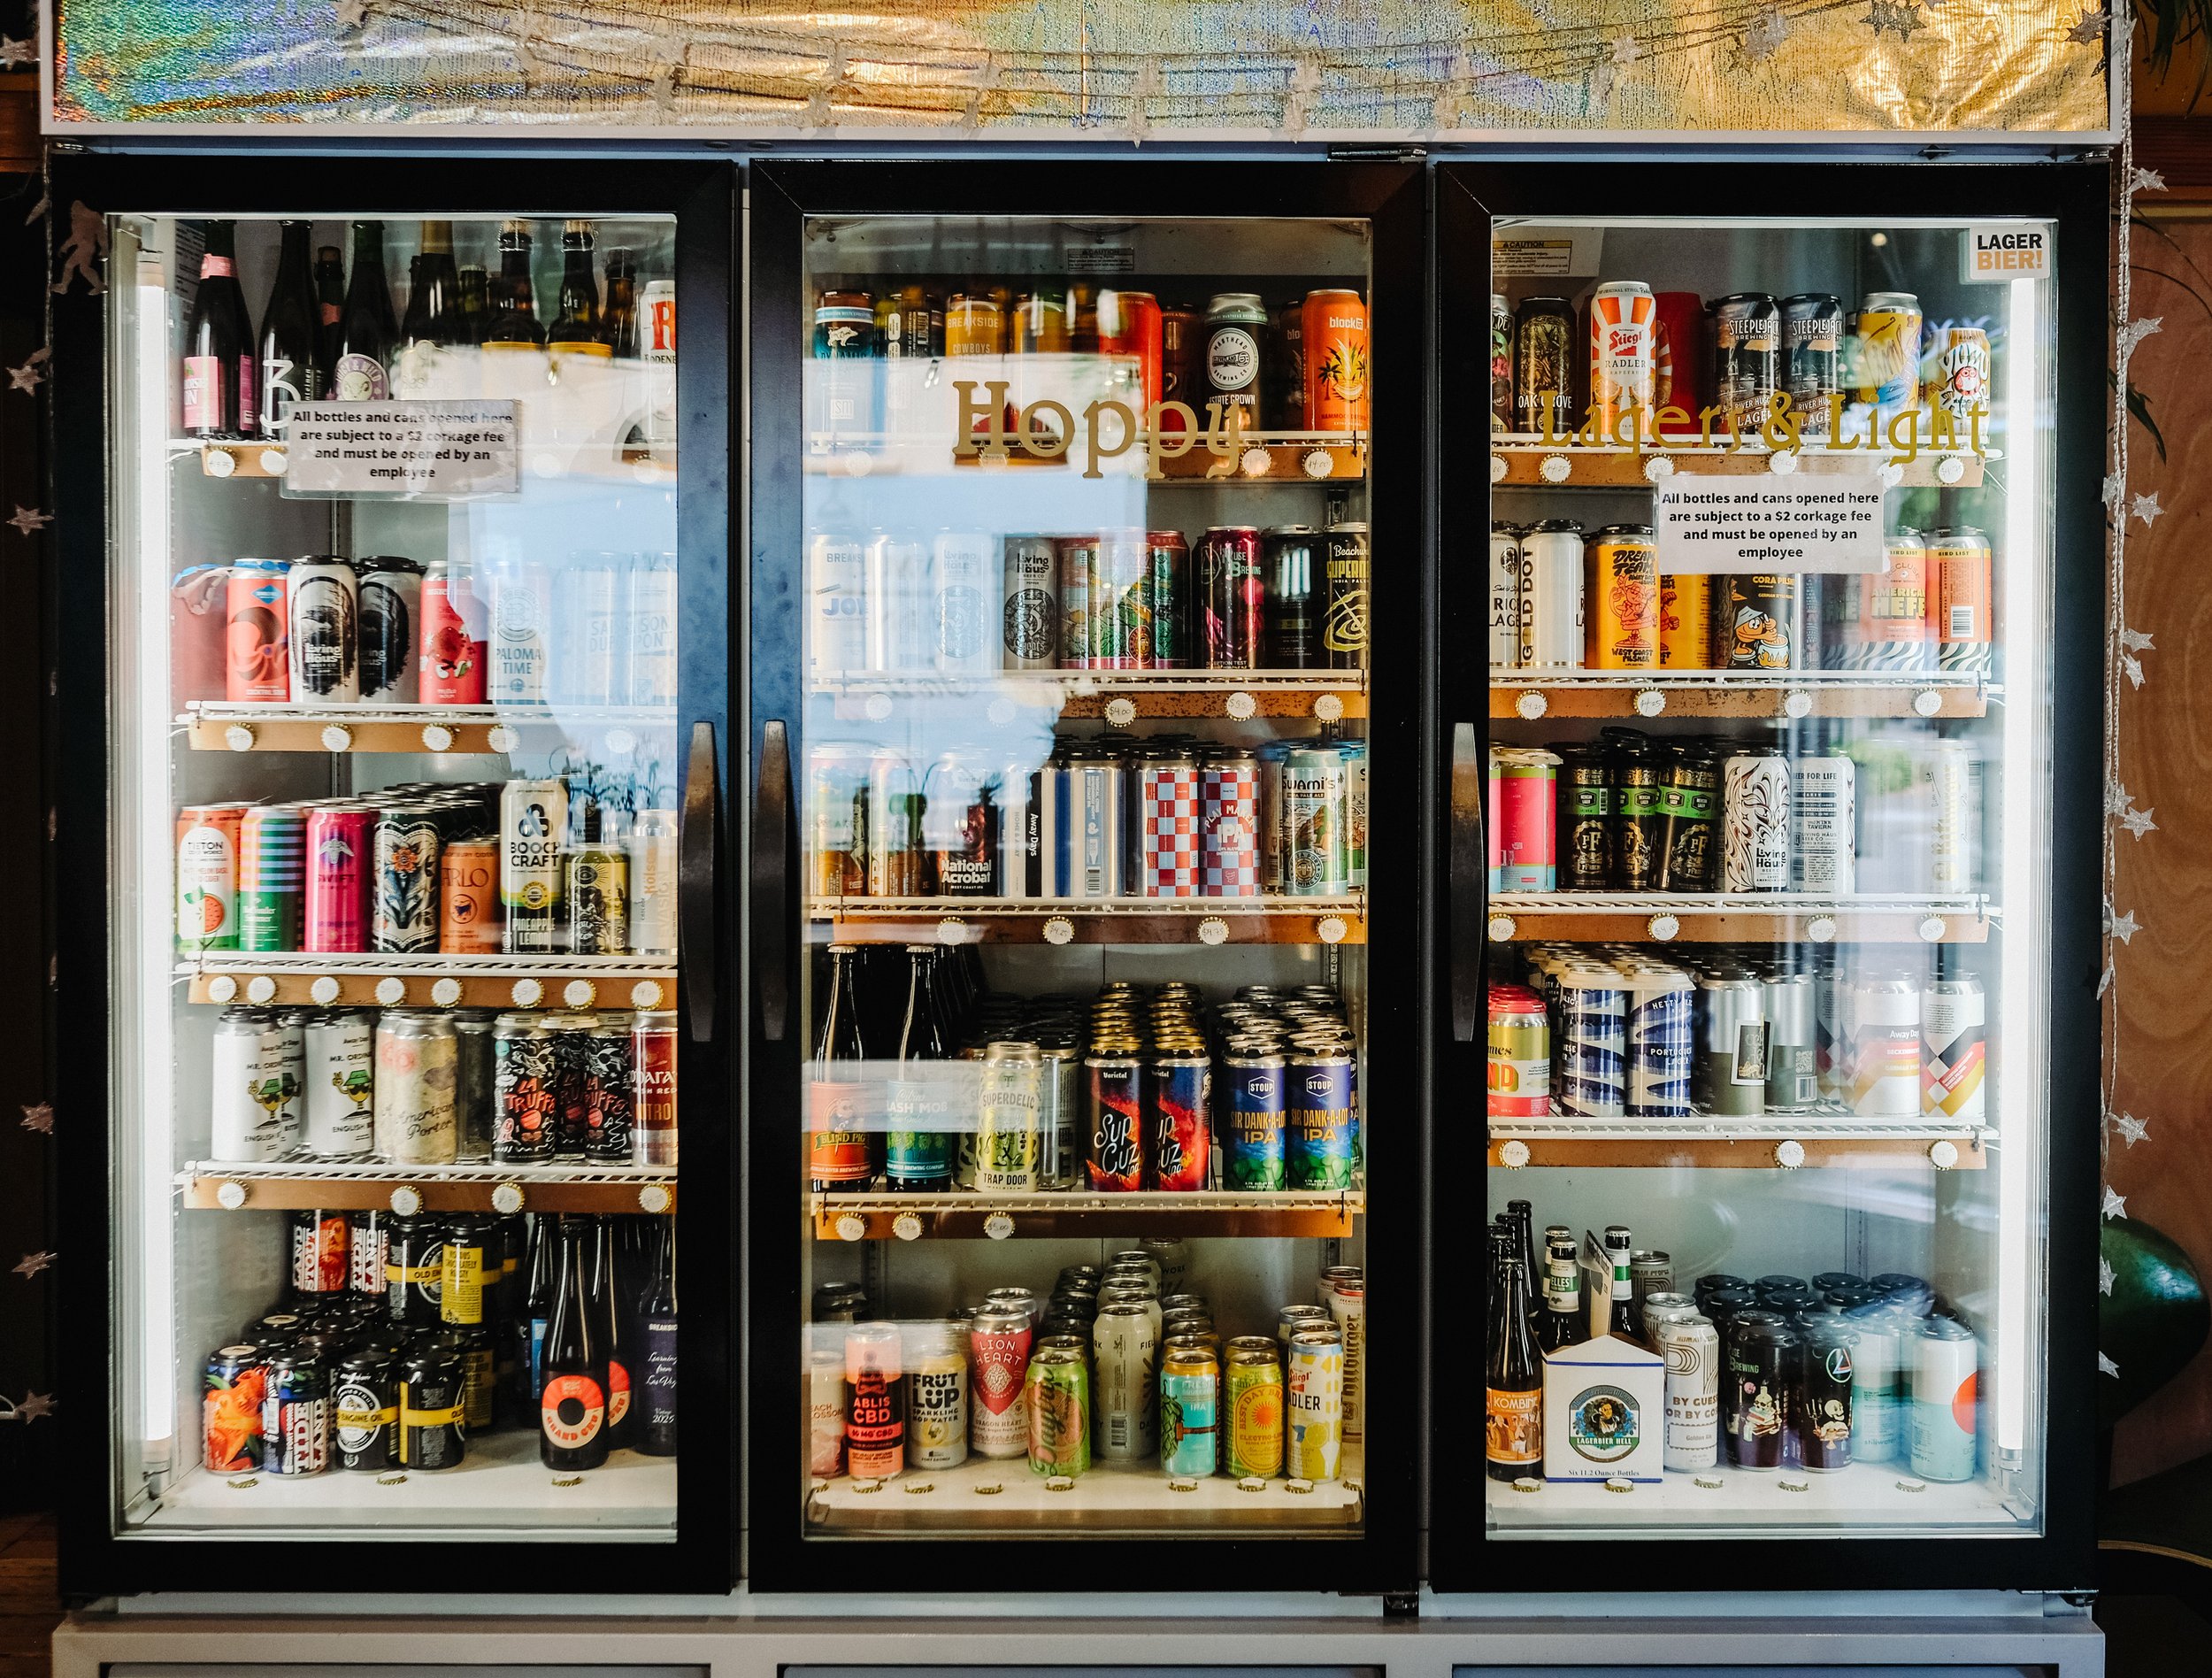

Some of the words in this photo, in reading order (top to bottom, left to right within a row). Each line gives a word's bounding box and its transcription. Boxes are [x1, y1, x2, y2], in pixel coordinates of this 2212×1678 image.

[1513, 240, 1545, 249] CAUTION
[1977, 234, 2043, 250] LAGER
[1977, 250, 2043, 271] BIER!
[948, 318, 999, 329] BREAKSIDE
[1728, 319, 1780, 336] STEEPLEJACK
[1792, 319, 1843, 336] STEEPLEJACK
[952, 343, 991, 354] COWBOYS
[1213, 336, 1248, 351] MASTHEAD
[1609, 331, 1643, 352] Stiegl
[1605, 358, 1647, 369] RADLER
[1213, 367, 1239, 381] BREWING
[1230, 394, 1256, 405] GROWN
[1517, 396, 1537, 409] OAK
[1798, 399, 1816, 412] RIVER
[293, 411, 311, 423] All
[315, 411, 362, 423] bottles
[365, 411, 390, 423] and
[394, 413, 425, 424] cans
[428, 412, 477, 428] opened
[481, 412, 513, 424] here
[952, 381, 1240, 479] Hoppy
[1539, 390, 1744, 464] Lagers
[1763, 391, 1807, 458] &
[1825, 392, 1990, 468] Light
[300, 433, 322, 442] are
[326, 429, 375, 445] subject
[379, 431, 393, 442] to
[407, 430, 422, 443] $2
[426, 430, 480, 446] corkage
[483, 430, 505, 443] fee
[315, 449, 340, 459] and
[343, 449, 378, 459] must
[380, 448, 397, 459] be
[401, 449, 450, 465] opened
[453, 448, 470, 464] by
[473, 451, 491, 460] an
[369, 466, 435, 481] employee
[1662, 493, 1680, 504] All
[1683, 492, 1731, 504] bottles
[1733, 492, 1759, 504] and
[1762, 495, 1793, 504] cans
[1795, 493, 1845, 508] opened
[1848, 492, 1879, 504] here
[1669, 513, 1692, 522] are
[1694, 510, 1743, 525] subject
[1746, 512, 1762, 522] to
[1763, 513, 1772, 522] a
[1774, 510, 1791, 523] $2
[1793, 510, 1847, 525] corkage
[1850, 510, 1872, 522] fee
[1683, 528, 1709, 541] and
[1711, 530, 1747, 541] must
[1748, 528, 1766, 540] be
[1769, 528, 1818, 543] opened
[1821, 528, 1838, 543] by
[1840, 530, 1858, 540] an
[1612, 550, 1656, 564] DREAM
[1738, 547, 1803, 561] employee
[1522, 547, 1534, 592] DOT
[1612, 562, 1655, 576] TEAM
[1752, 575, 1776, 585] CORA
[495, 648, 541, 661] PALOMA
[1611, 647, 1632, 657] WEST
[1632, 647, 1654, 657] COAST
[503, 662, 533, 675] TIME
[1282, 775, 1337, 790] Swami's
[1204, 807, 1224, 828] PLAY
[1225, 804, 1256, 828] MAKER
[1029, 812, 1039, 835] Away
[1217, 823, 1246, 843] IPA
[188, 842, 224, 851] TIETON
[1029, 836, 1039, 857] Days
[511, 854, 560, 867] CRAFT
[941, 859, 992, 873] National
[941, 871, 992, 884] Acrobat
[518, 932, 549, 946] LEMON
[1651, 999, 1675, 1011] HETTY
[1889, 1029, 1910, 1040] Away
[1102, 1071, 1128, 1080] Varietal
[517, 1076, 540, 1094] LA
[1249, 1082, 1274, 1093] STOUP
[1307, 1080, 1333, 1090] STOUP
[918, 1101, 949, 1113] MOB
[981, 1092, 1035, 1109] SUPERDELIC
[1230, 1111, 1243, 1128] SIR
[1291, 1108, 1302, 1126] SIR
[332, 1124, 365, 1134] ENGLISH
[407, 1119, 453, 1141] Porter
[1303, 1128, 1337, 1142] IPA
[851, 1132, 867, 1143] PIG
[1244, 1129, 1277, 1144] IPA
[983, 1174, 1004, 1185] TRAP
[1006, 1174, 1028, 1186] DOOR
[413, 1270, 431, 1279] OLD
[979, 1339, 1017, 1351] LION
[975, 1351, 1023, 1366] HEART
[1728, 1355, 1760, 1374] BREWING
[656, 1364, 672, 1374] from
[853, 1396, 891, 1408] ABLIS
[1245, 1389, 1265, 1405] DAY
[1672, 1396, 1689, 1405] BY
[1190, 1403, 1207, 1412] IPA
[1665, 1408, 1683, 1419] OR
[1685, 1409, 1701, 1420] BY
[369, 1412, 385, 1422] OIL
[652, 1415, 675, 1424] 2025
[853, 1407, 891, 1424] CBD
[546, 1414, 579, 1441] GRAND
[580, 1413, 598, 1437] CRU
[975, 1419, 1001, 1428] DRAGON
[294, 1401, 308, 1474] TIDE
[313, 1397, 325, 1470] LAND
[1576, 1437, 1614, 1446] LAGERBIER
